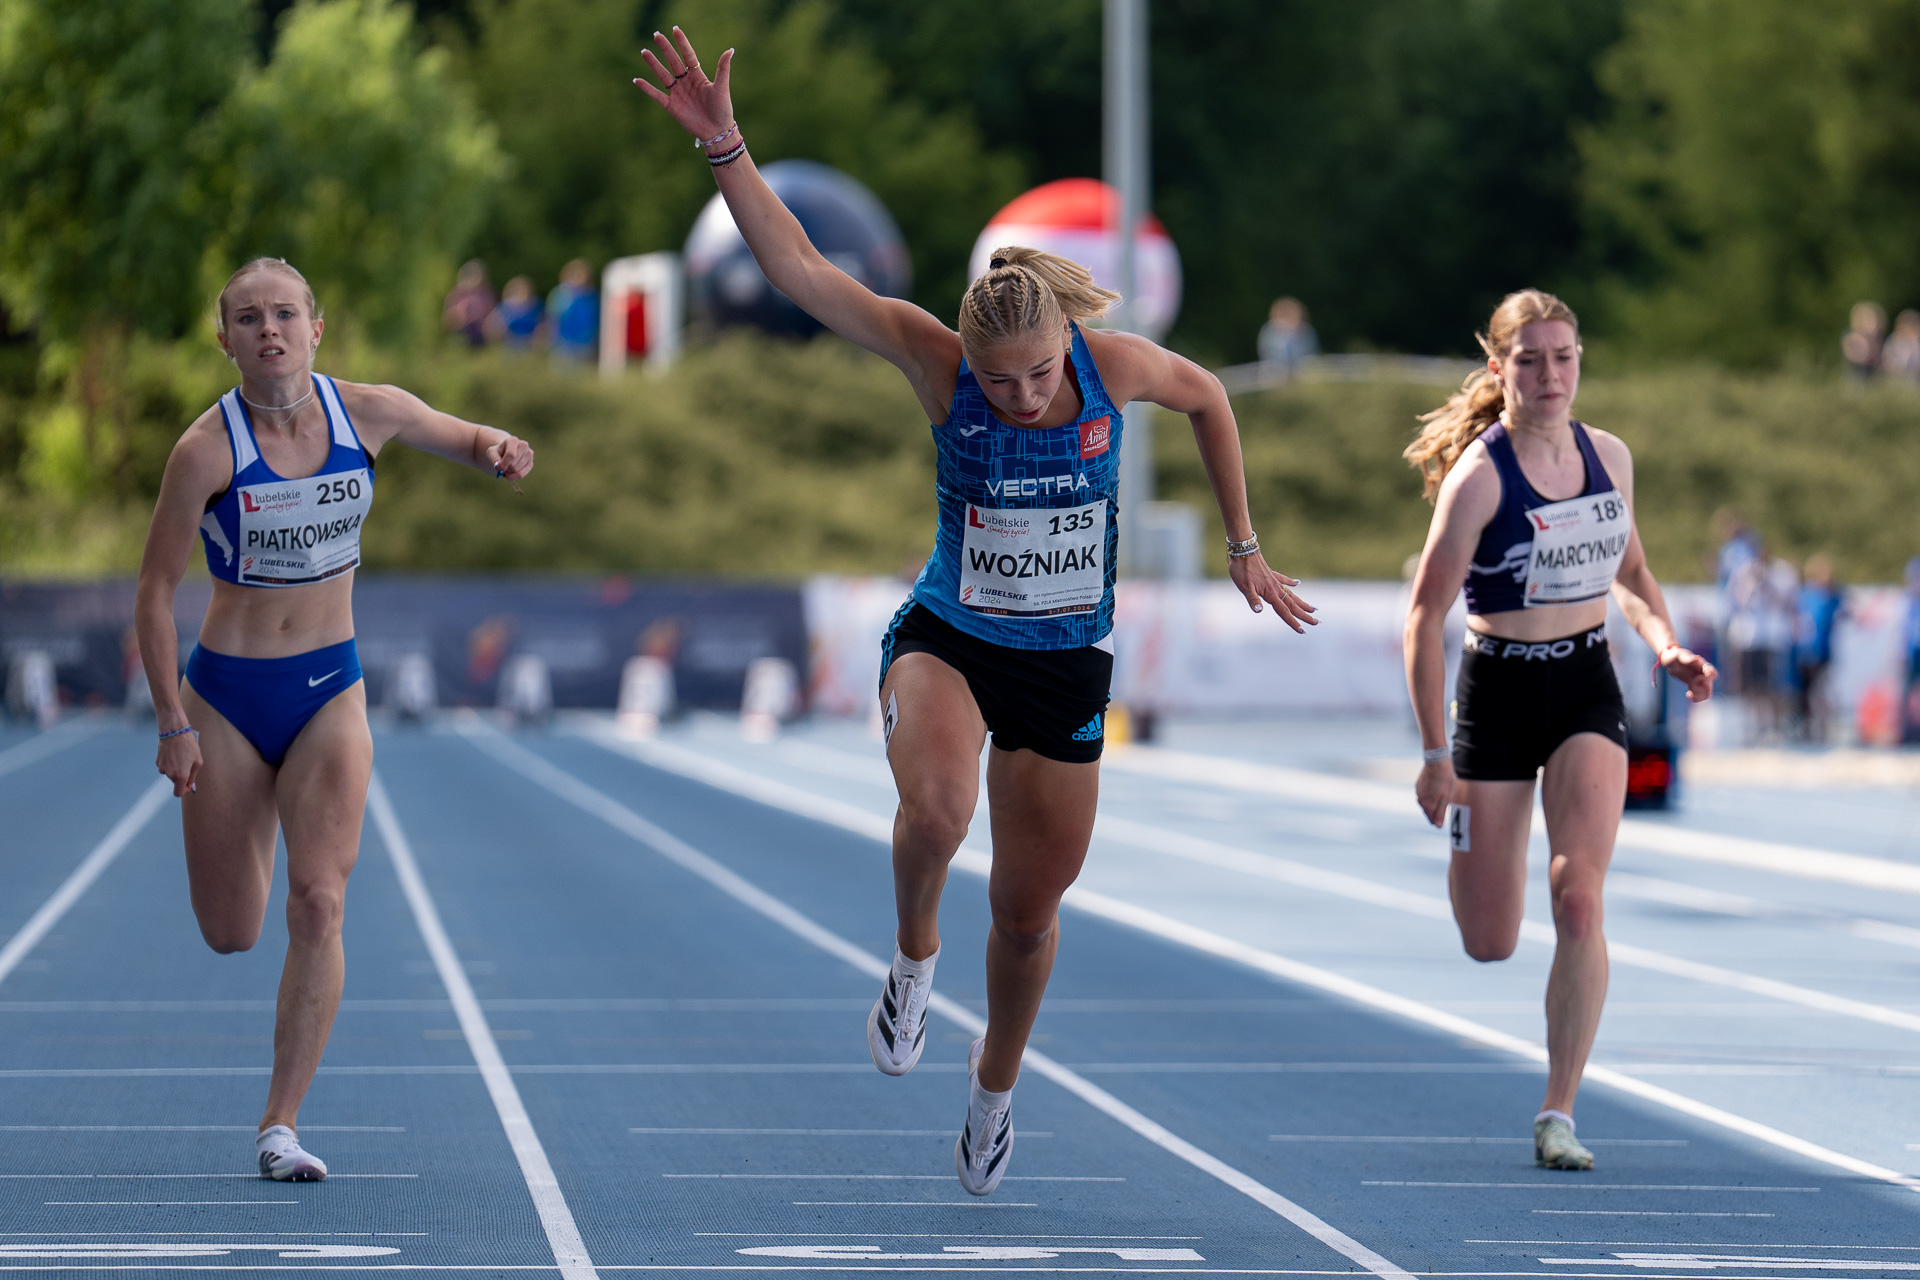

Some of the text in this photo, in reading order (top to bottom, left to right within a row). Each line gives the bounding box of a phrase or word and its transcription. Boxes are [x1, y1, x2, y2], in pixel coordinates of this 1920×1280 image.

[316, 478, 361, 505] 250
[985, 472, 1090, 497] VECTRA
[248, 513, 361, 552] PIĄTKOWSKA
[1049, 509, 1094, 536] 135
[969, 543, 1098, 579] WOŹNIAK
[1535, 531, 1627, 570] MARCYNIUK
[259, 565, 280, 575] 2024
[260, 558, 306, 569] LUBELSKIE
[978, 594, 1001, 604] 2024
[980, 587, 1029, 601] LUBELSKIE
[983, 607, 1008, 615] LUBLIN
[1501, 640, 1576, 662] PRO
